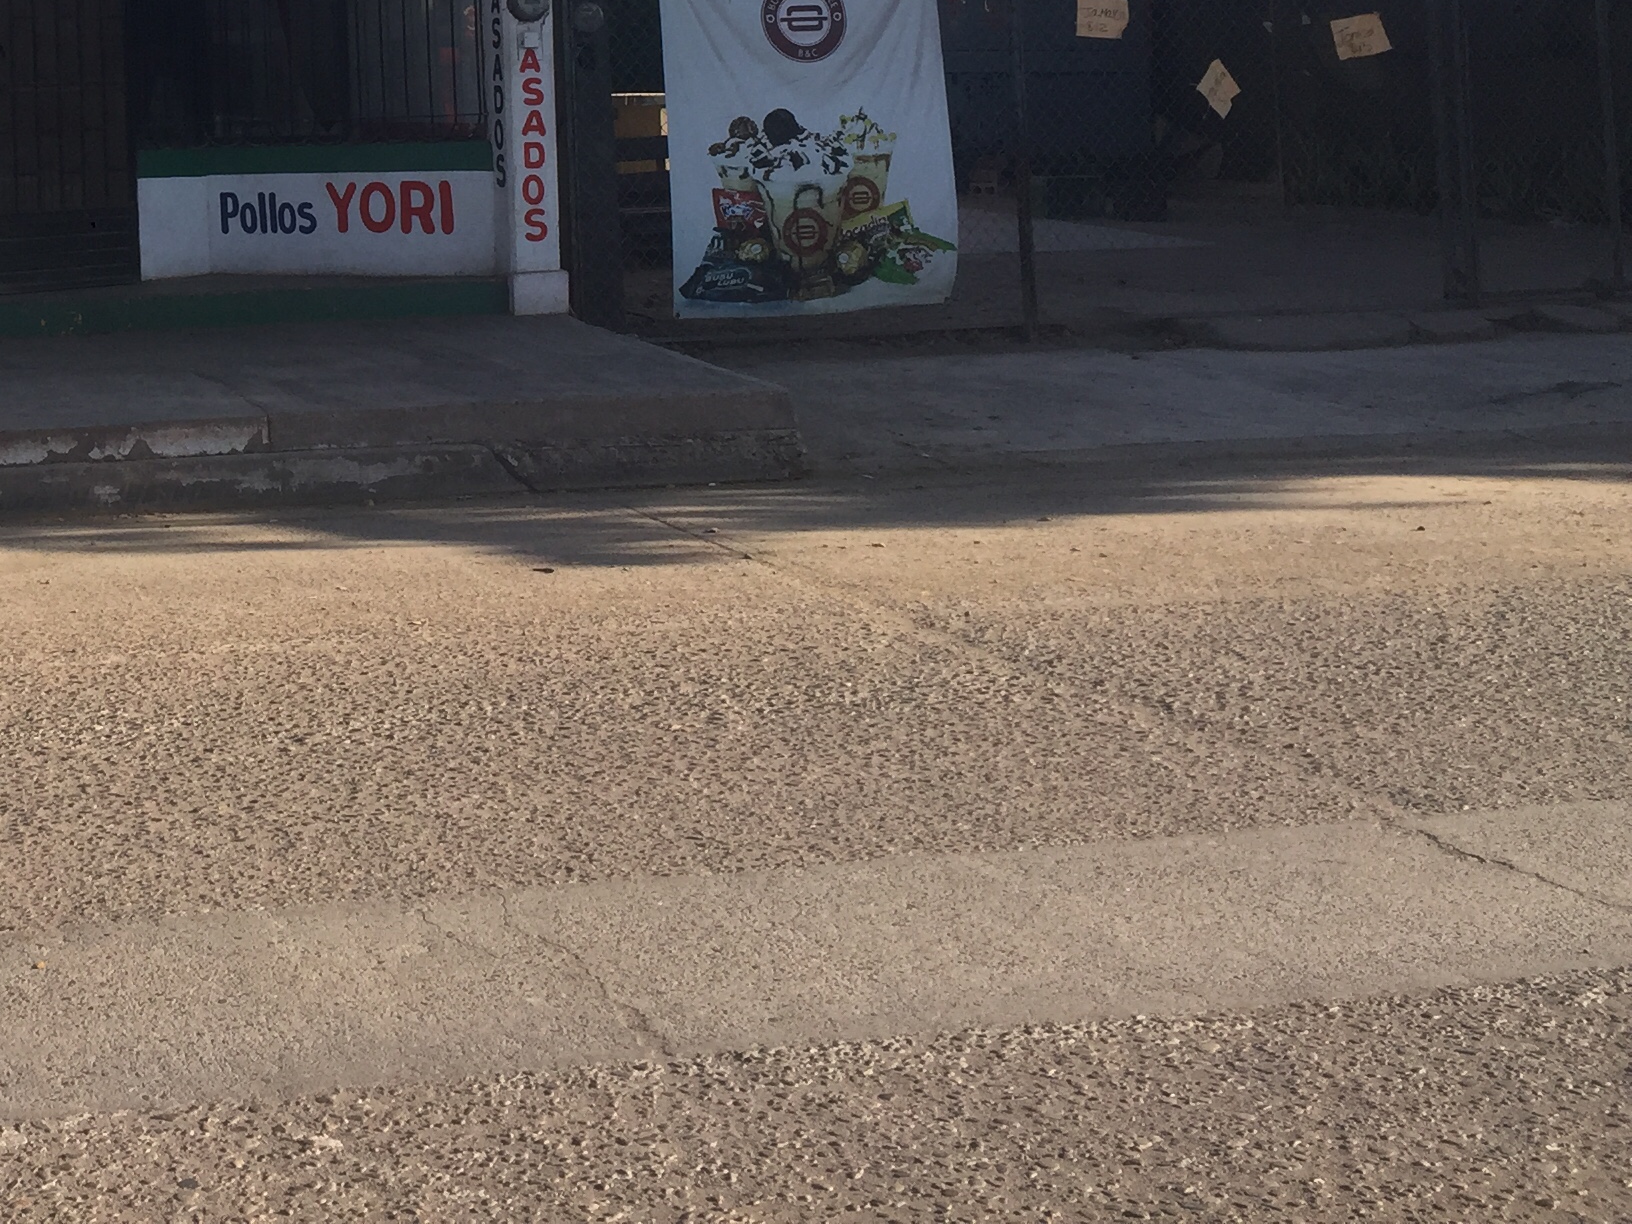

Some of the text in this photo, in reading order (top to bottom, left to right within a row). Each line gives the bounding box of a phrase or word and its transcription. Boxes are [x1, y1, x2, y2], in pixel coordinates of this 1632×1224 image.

[519, 48, 549, 242] ASADOS
[220, 180, 455, 235] Pollos YORI
